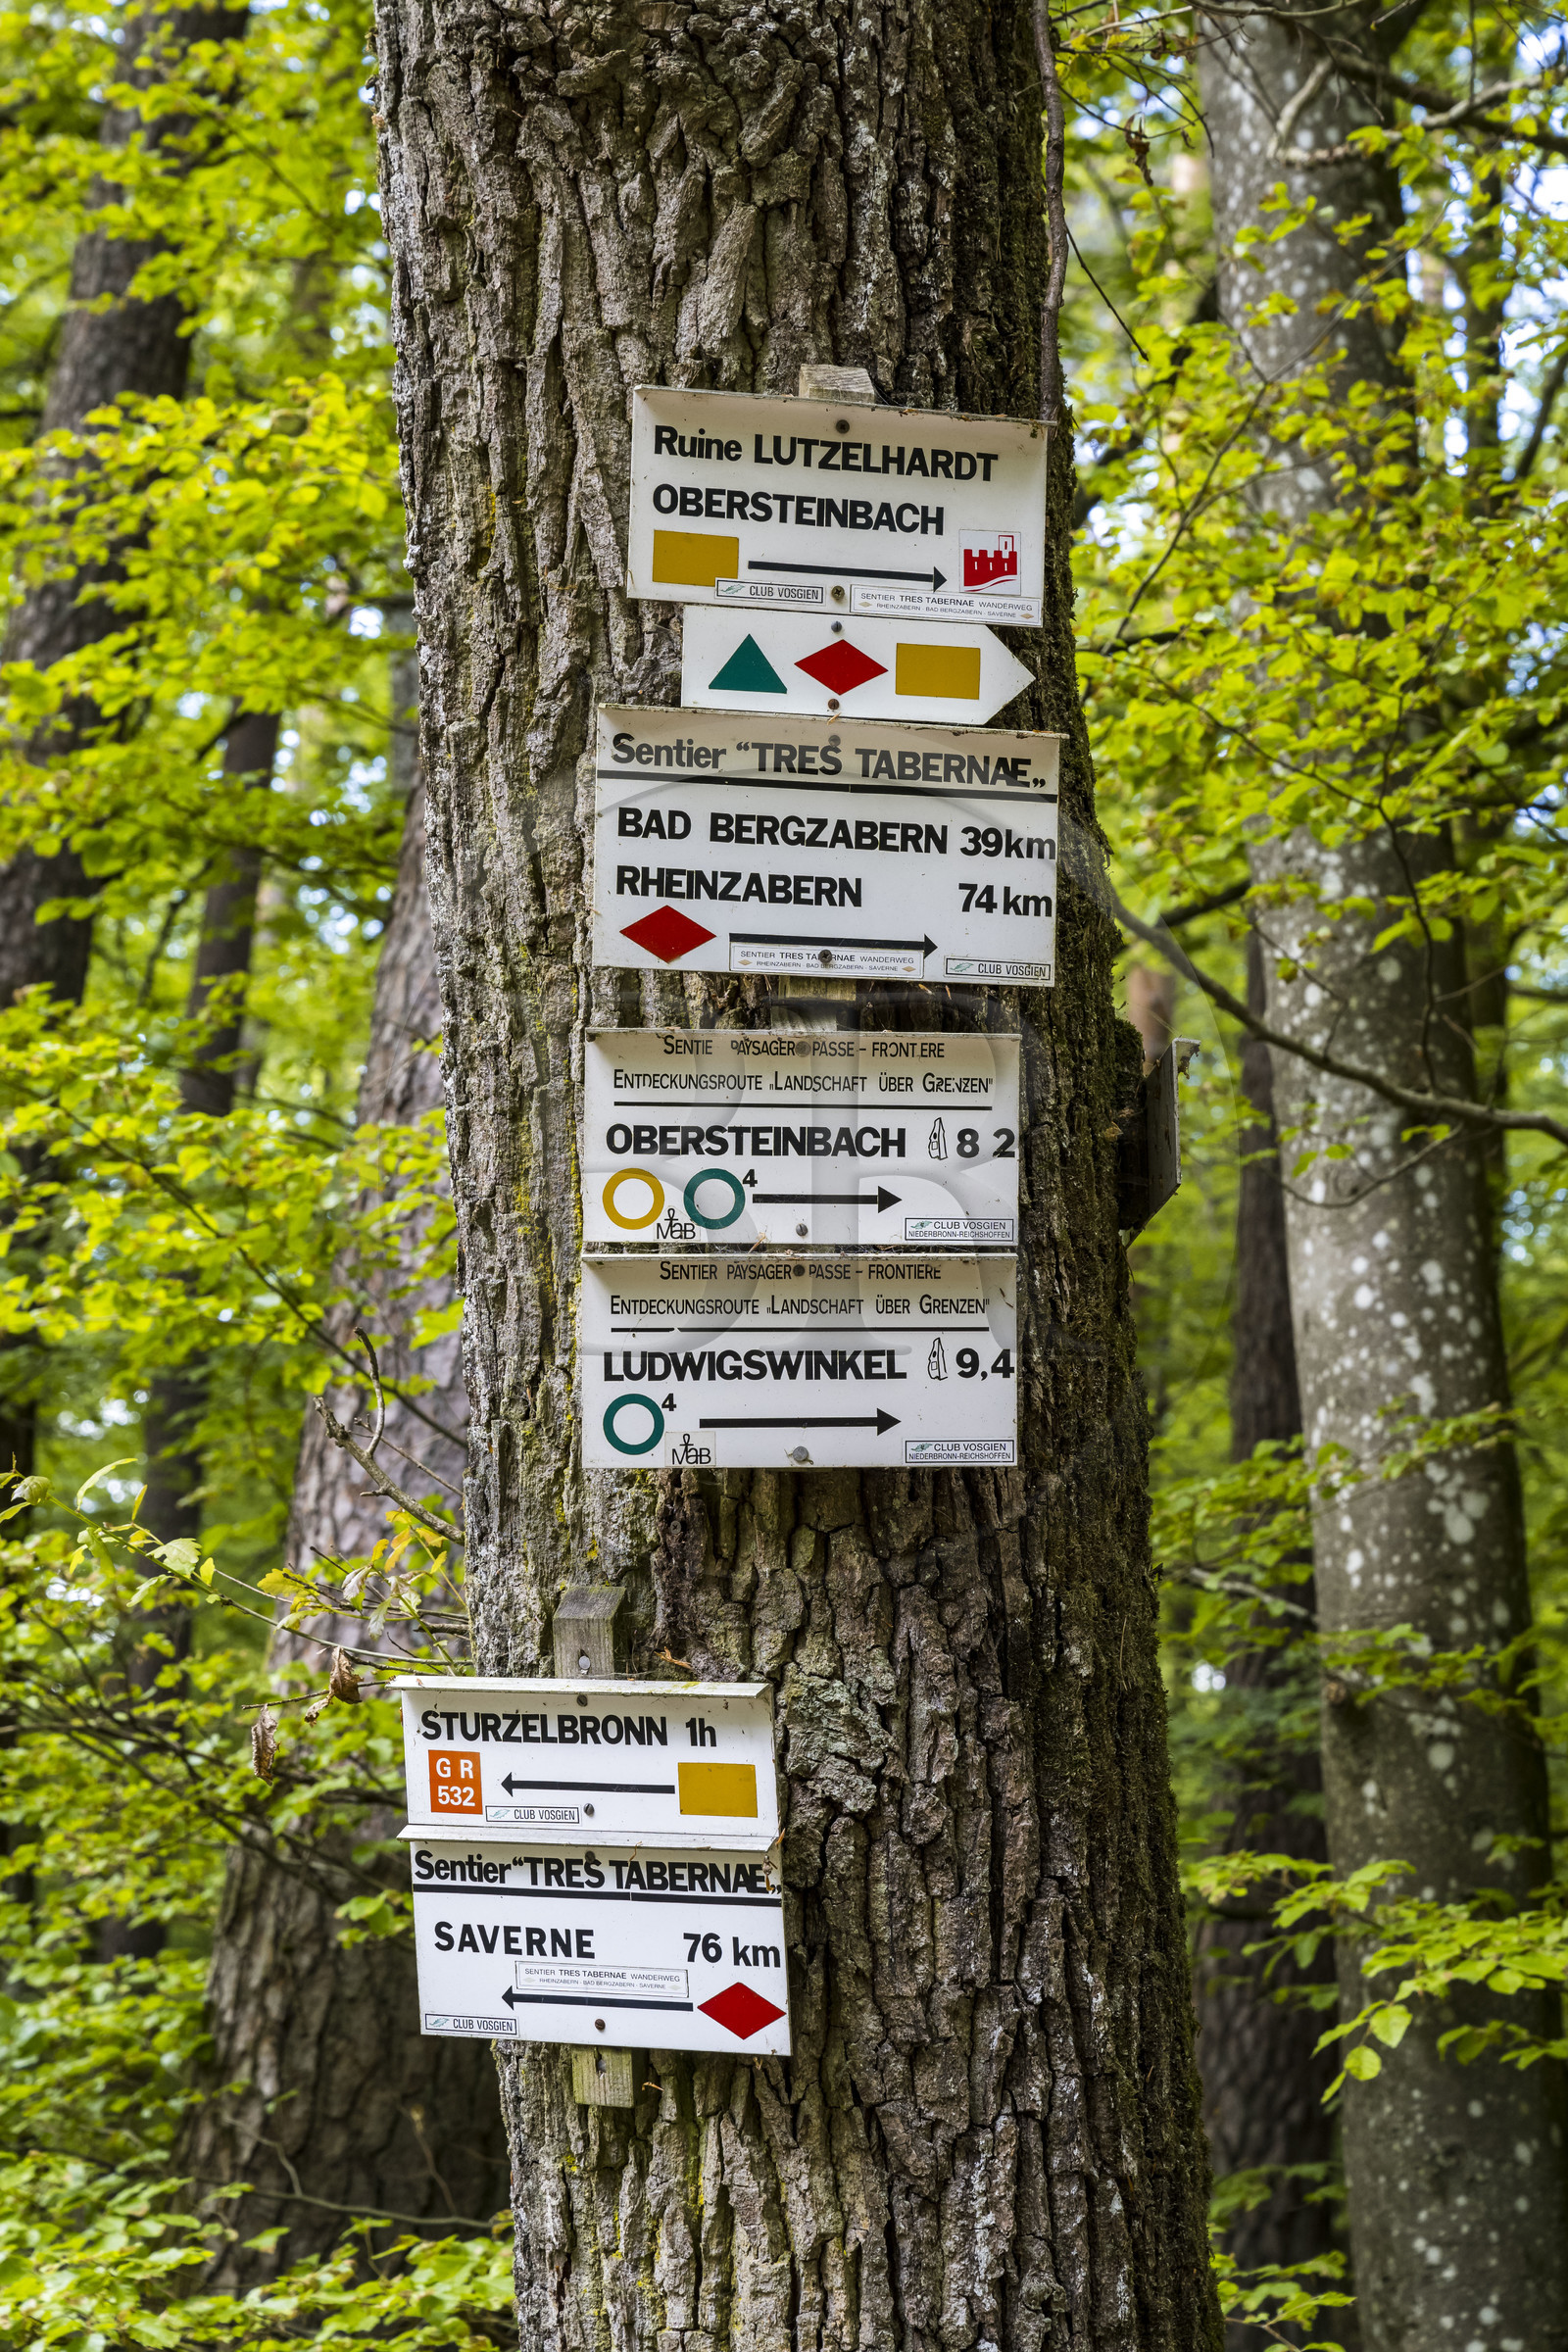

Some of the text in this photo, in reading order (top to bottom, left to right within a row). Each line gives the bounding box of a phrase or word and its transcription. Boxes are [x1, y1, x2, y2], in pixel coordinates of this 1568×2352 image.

[655, 425, 998, 482] Ruine LUTZELHARDT
[653, 483, 944, 535] OBERSTEINBACH
[750, 585, 819, 600] CLUB VOSGIEN
[860, 592, 1033, 612] SENTIER TRES TABERNAE WANDERWEG
[876, 603, 921, 612] RHEINZABERN
[612, 732, 727, 769] Sentier
[617, 807, 692, 841] BAD
[710, 812, 948, 855] BERGZABERN
[615, 864, 862, 907] RHEINZABERN
[779, 952, 804, 960] TRES
[806, 953, 856, 962] TARNAE
[859, 956, 914, 964] WANDERWEG
[978, 962, 1047, 978] CLUB VOSGIEN
[811, 1041, 855, 1057] PASSE
[872, 1042, 945, 1058] FRONTERE
[878, 1071, 913, 1093] ÜBER
[606, 1123, 906, 1158] OBERSTEINBACH
[743, 1168, 758, 1188] 4
[933, 1221, 1006, 1230] CLUB VOSGIEN
[660, 1260, 717, 1280] SENTIER
[727, 1263, 792, 1280] PAYSAGER
[808, 1263, 851, 1280] PASSE
[868, 1263, 942, 1280] FRONTIERE
[610, 1295, 759, 1315] ENTDECKUNGSROUTE
[875, 1296, 910, 1315] ÜBER
[604, 1348, 1015, 1382] LUDWIGSWINKEL 9,4
[661, 1393, 676, 1411] 4
[933, 1443, 1006, 1451] CLUB VOSGIEN
[420, 1710, 717, 1747] STURZELBRONN 1h
[437, 1786, 476, 1807] 532
[514, 1809, 575, 1821] CLUB VOSGIEN
[415, 1850, 512, 1885] Sentier
[434, 1921, 780, 1968] SAVERNE 76 km
[559, 1969, 580, 1978] TRES
[582, 1970, 627, 1980] TABERNAE
[453, 2017, 514, 2033] CLUB VOSGIEN
